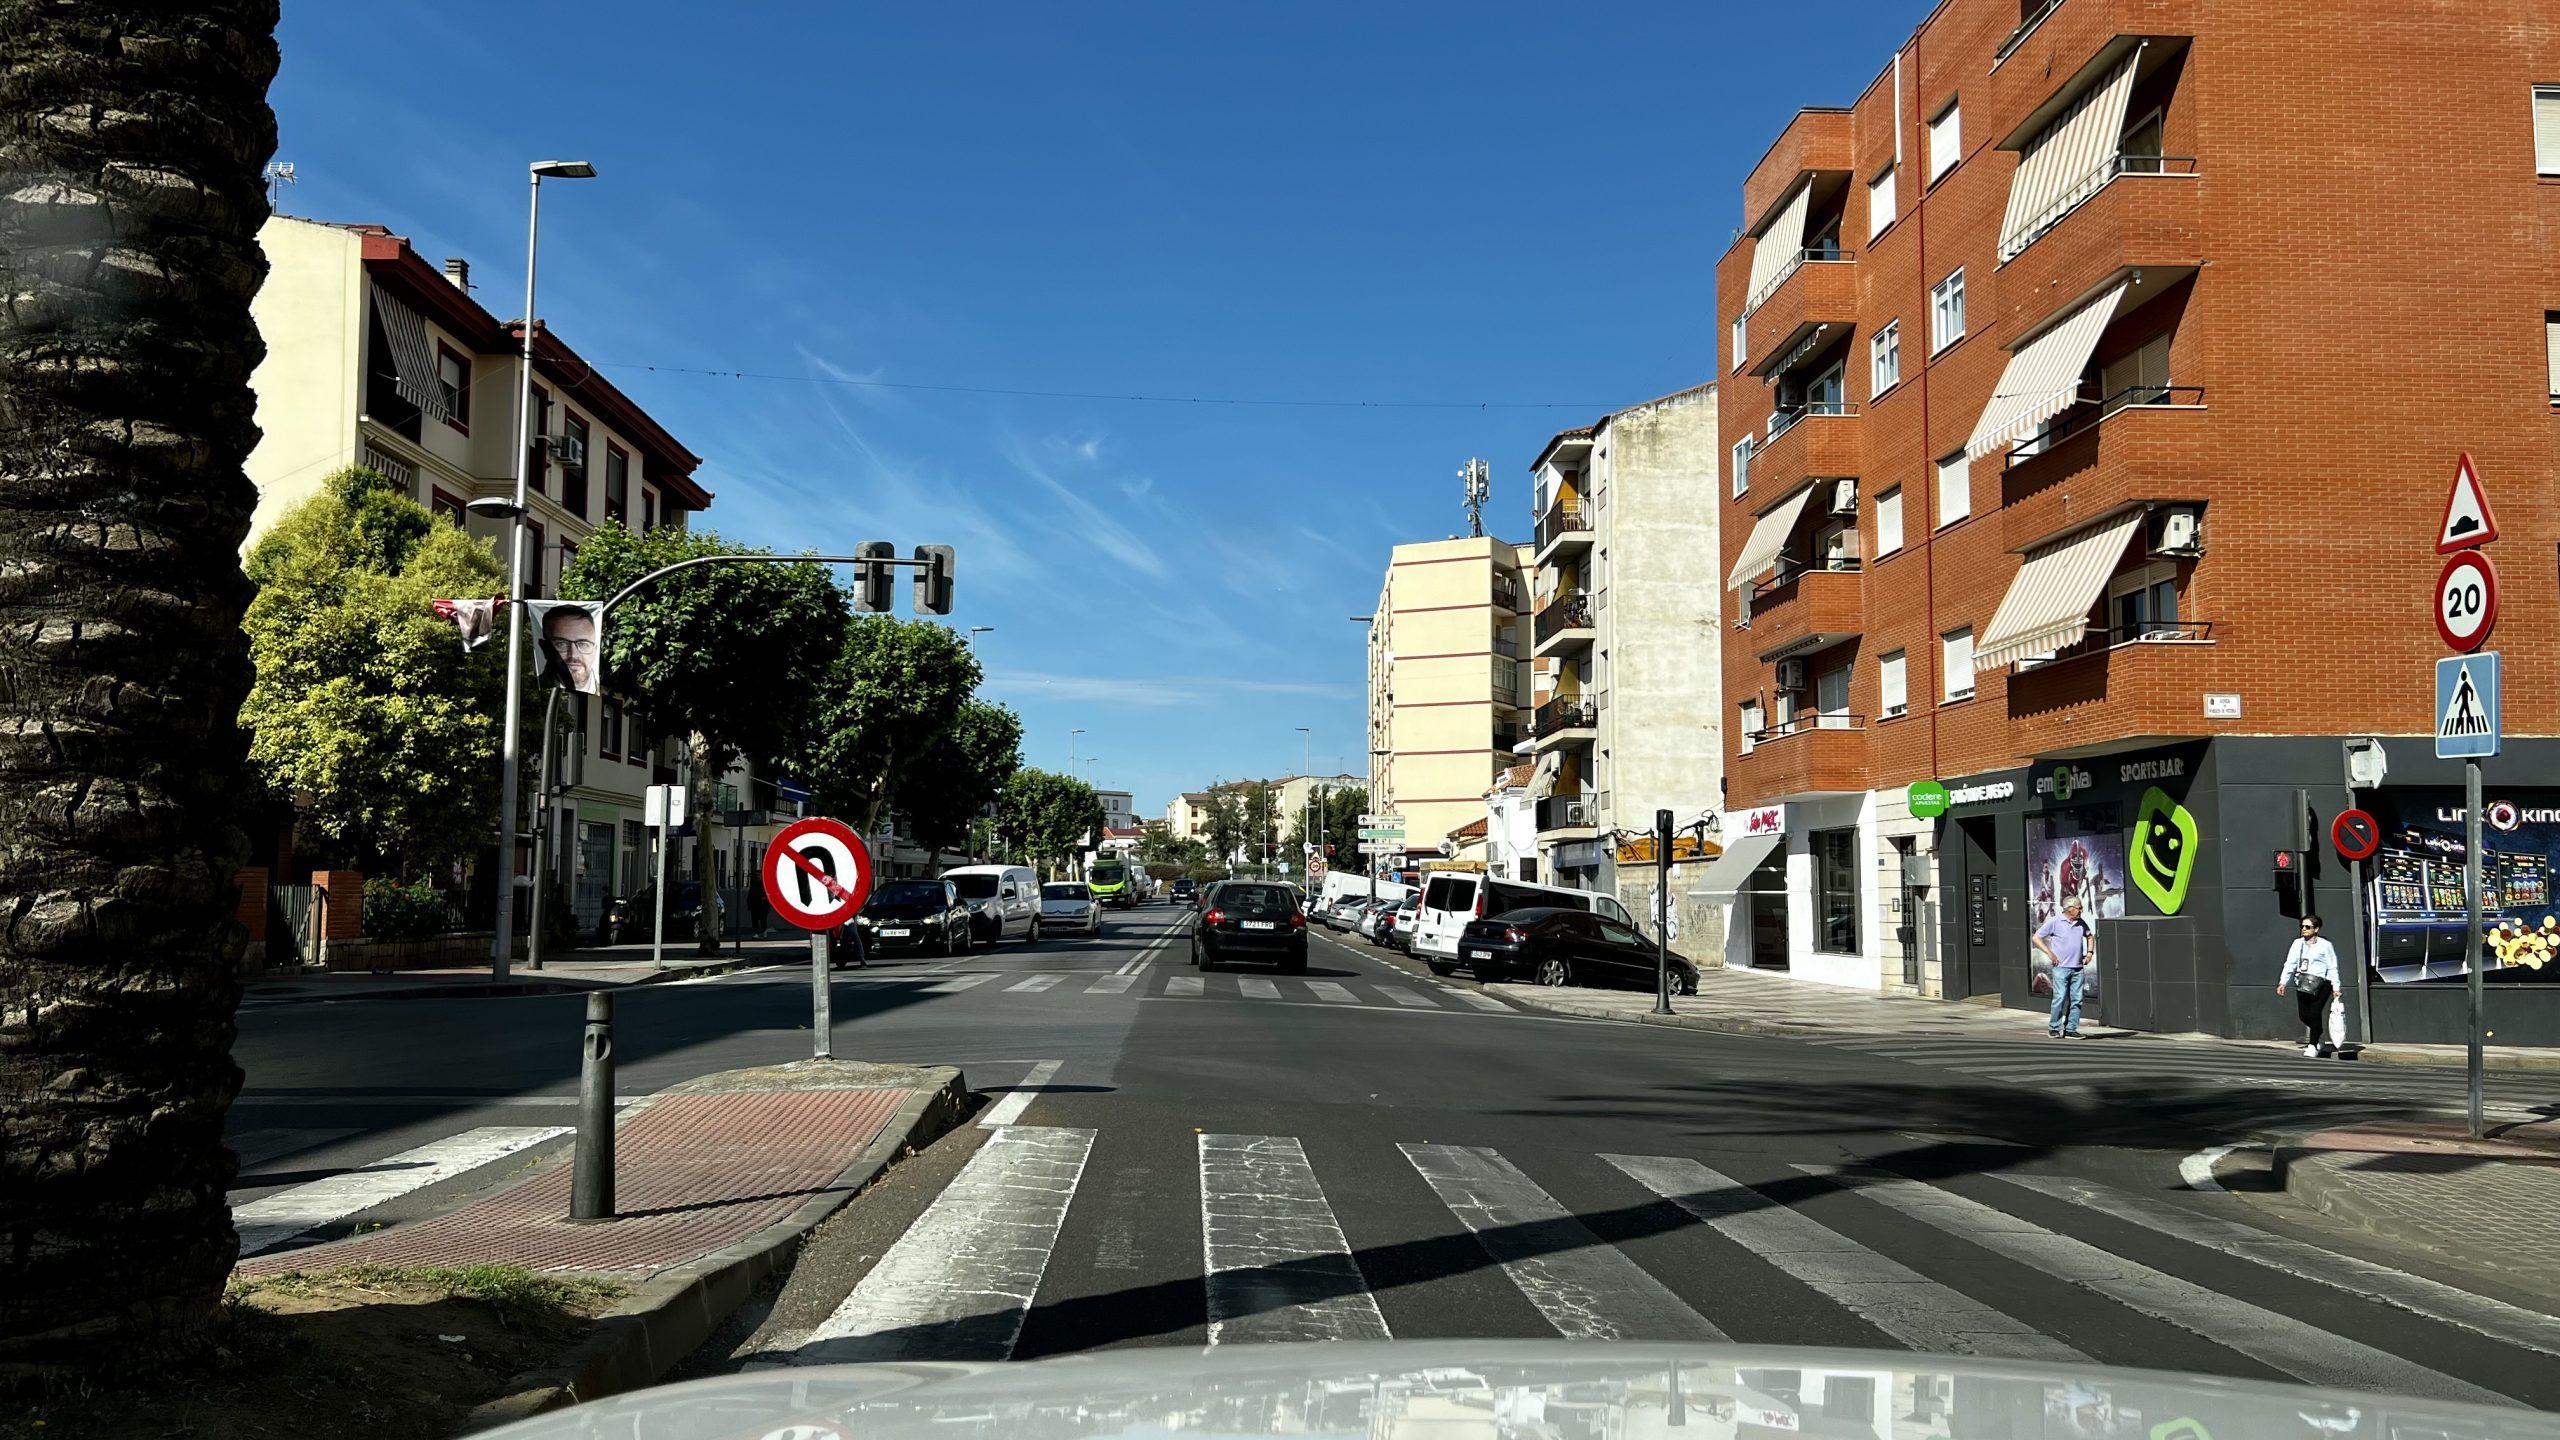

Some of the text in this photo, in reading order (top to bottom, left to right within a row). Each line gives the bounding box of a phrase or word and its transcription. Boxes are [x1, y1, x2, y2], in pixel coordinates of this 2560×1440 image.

[2448, 583, 2480, 618] 20
[2121, 758, 2182, 783] SPORTS BAR
[1912, 789, 1942, 801] codere
[2437, 807, 2485, 822] LIN
